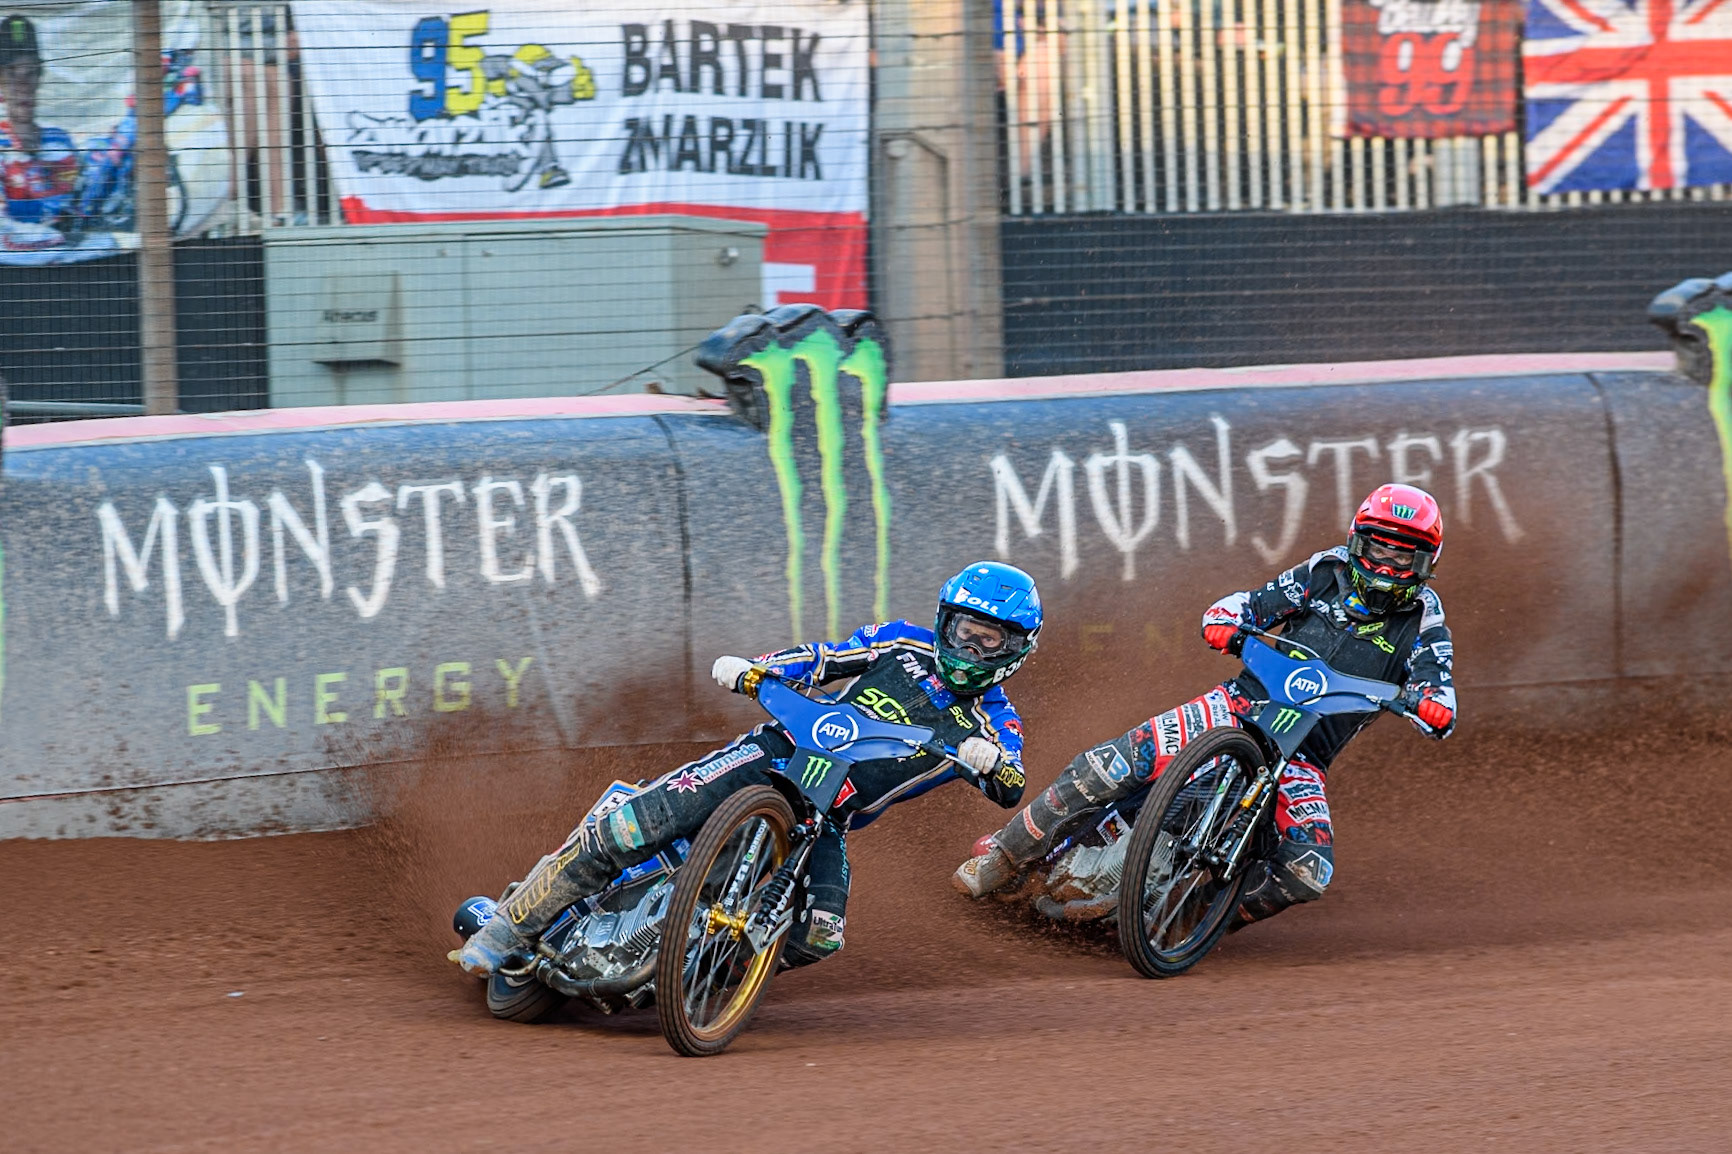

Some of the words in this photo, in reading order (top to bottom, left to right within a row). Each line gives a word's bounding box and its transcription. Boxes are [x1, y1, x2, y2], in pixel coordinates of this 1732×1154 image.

[410, 10, 491, 121] 95
[622, 19, 822, 102] BARTEK
[1378, 31, 1476, 116] 99
[619, 113, 825, 181] ZMARZLIK
[98, 460, 600, 641] MONSTER
[896, 652, 928, 679] FIM
[1291, 677, 1320, 695] ATPI
[187, 657, 533, 736] ENERGY
[949, 705, 973, 729] SGP
[818, 722, 851, 741] ATPI
[694, 743, 760, 779] burnside
[1089, 743, 1132, 783] AB
